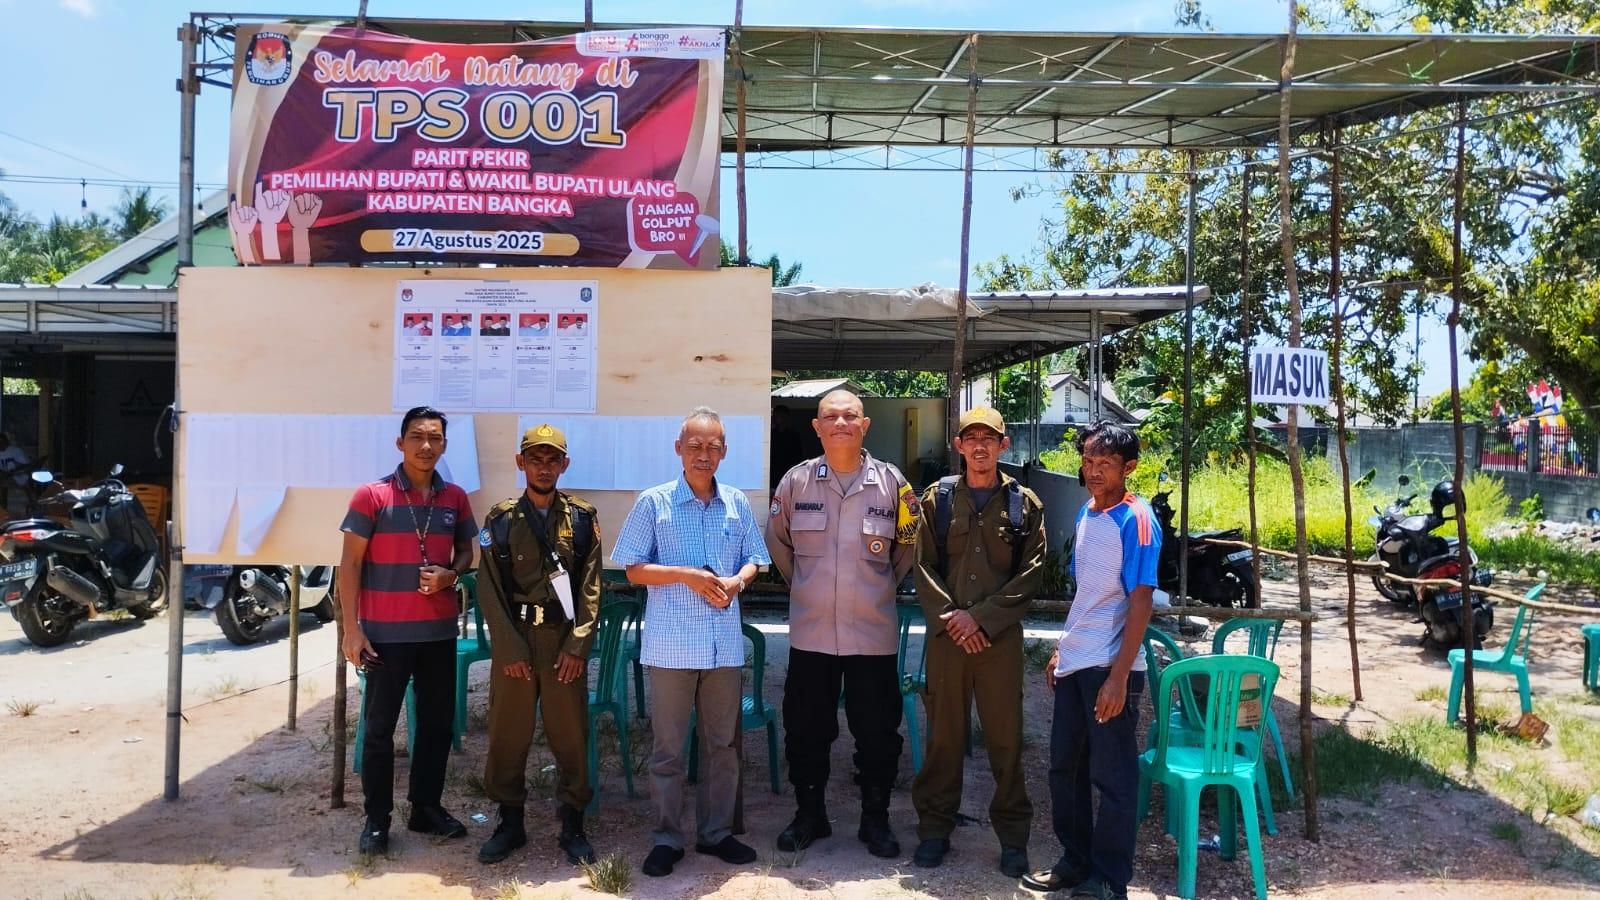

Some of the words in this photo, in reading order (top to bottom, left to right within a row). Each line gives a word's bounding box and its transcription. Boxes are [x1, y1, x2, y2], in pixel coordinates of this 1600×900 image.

[314, 50, 450, 83] Selamat
[464, 55, 583, 92] Datang
[596, 56, 639, 88] di
[323, 87, 469, 142] TPS
[480, 90, 627, 148] 001
[413, 150, 467, 166] PARIT
[472, 150, 529, 167] PEKIR
[271, 172, 373, 189] PEMILIHAN
[377, 172, 444, 188] BUPATI
[449, 173, 463, 188] &
[468, 172, 531, 191] WAKIL
[535, 175, 604, 195] BUPATI
[608, 179, 675, 198] ULANG
[368, 194, 483, 211] KABUPATEN
[487, 196, 572, 215] BANGKA
[638, 203, 695, 216] JANGAN
[641, 216, 692, 229] GOLPUT
[395, 231, 417, 246] 27
[420, 231, 493, 249] Agustus
[497, 233, 542, 249] 2025
[650, 230, 676, 242] BRO
[1253, 353, 1325, 399] MASUK
[867, 506, 895, 519] POLRI
